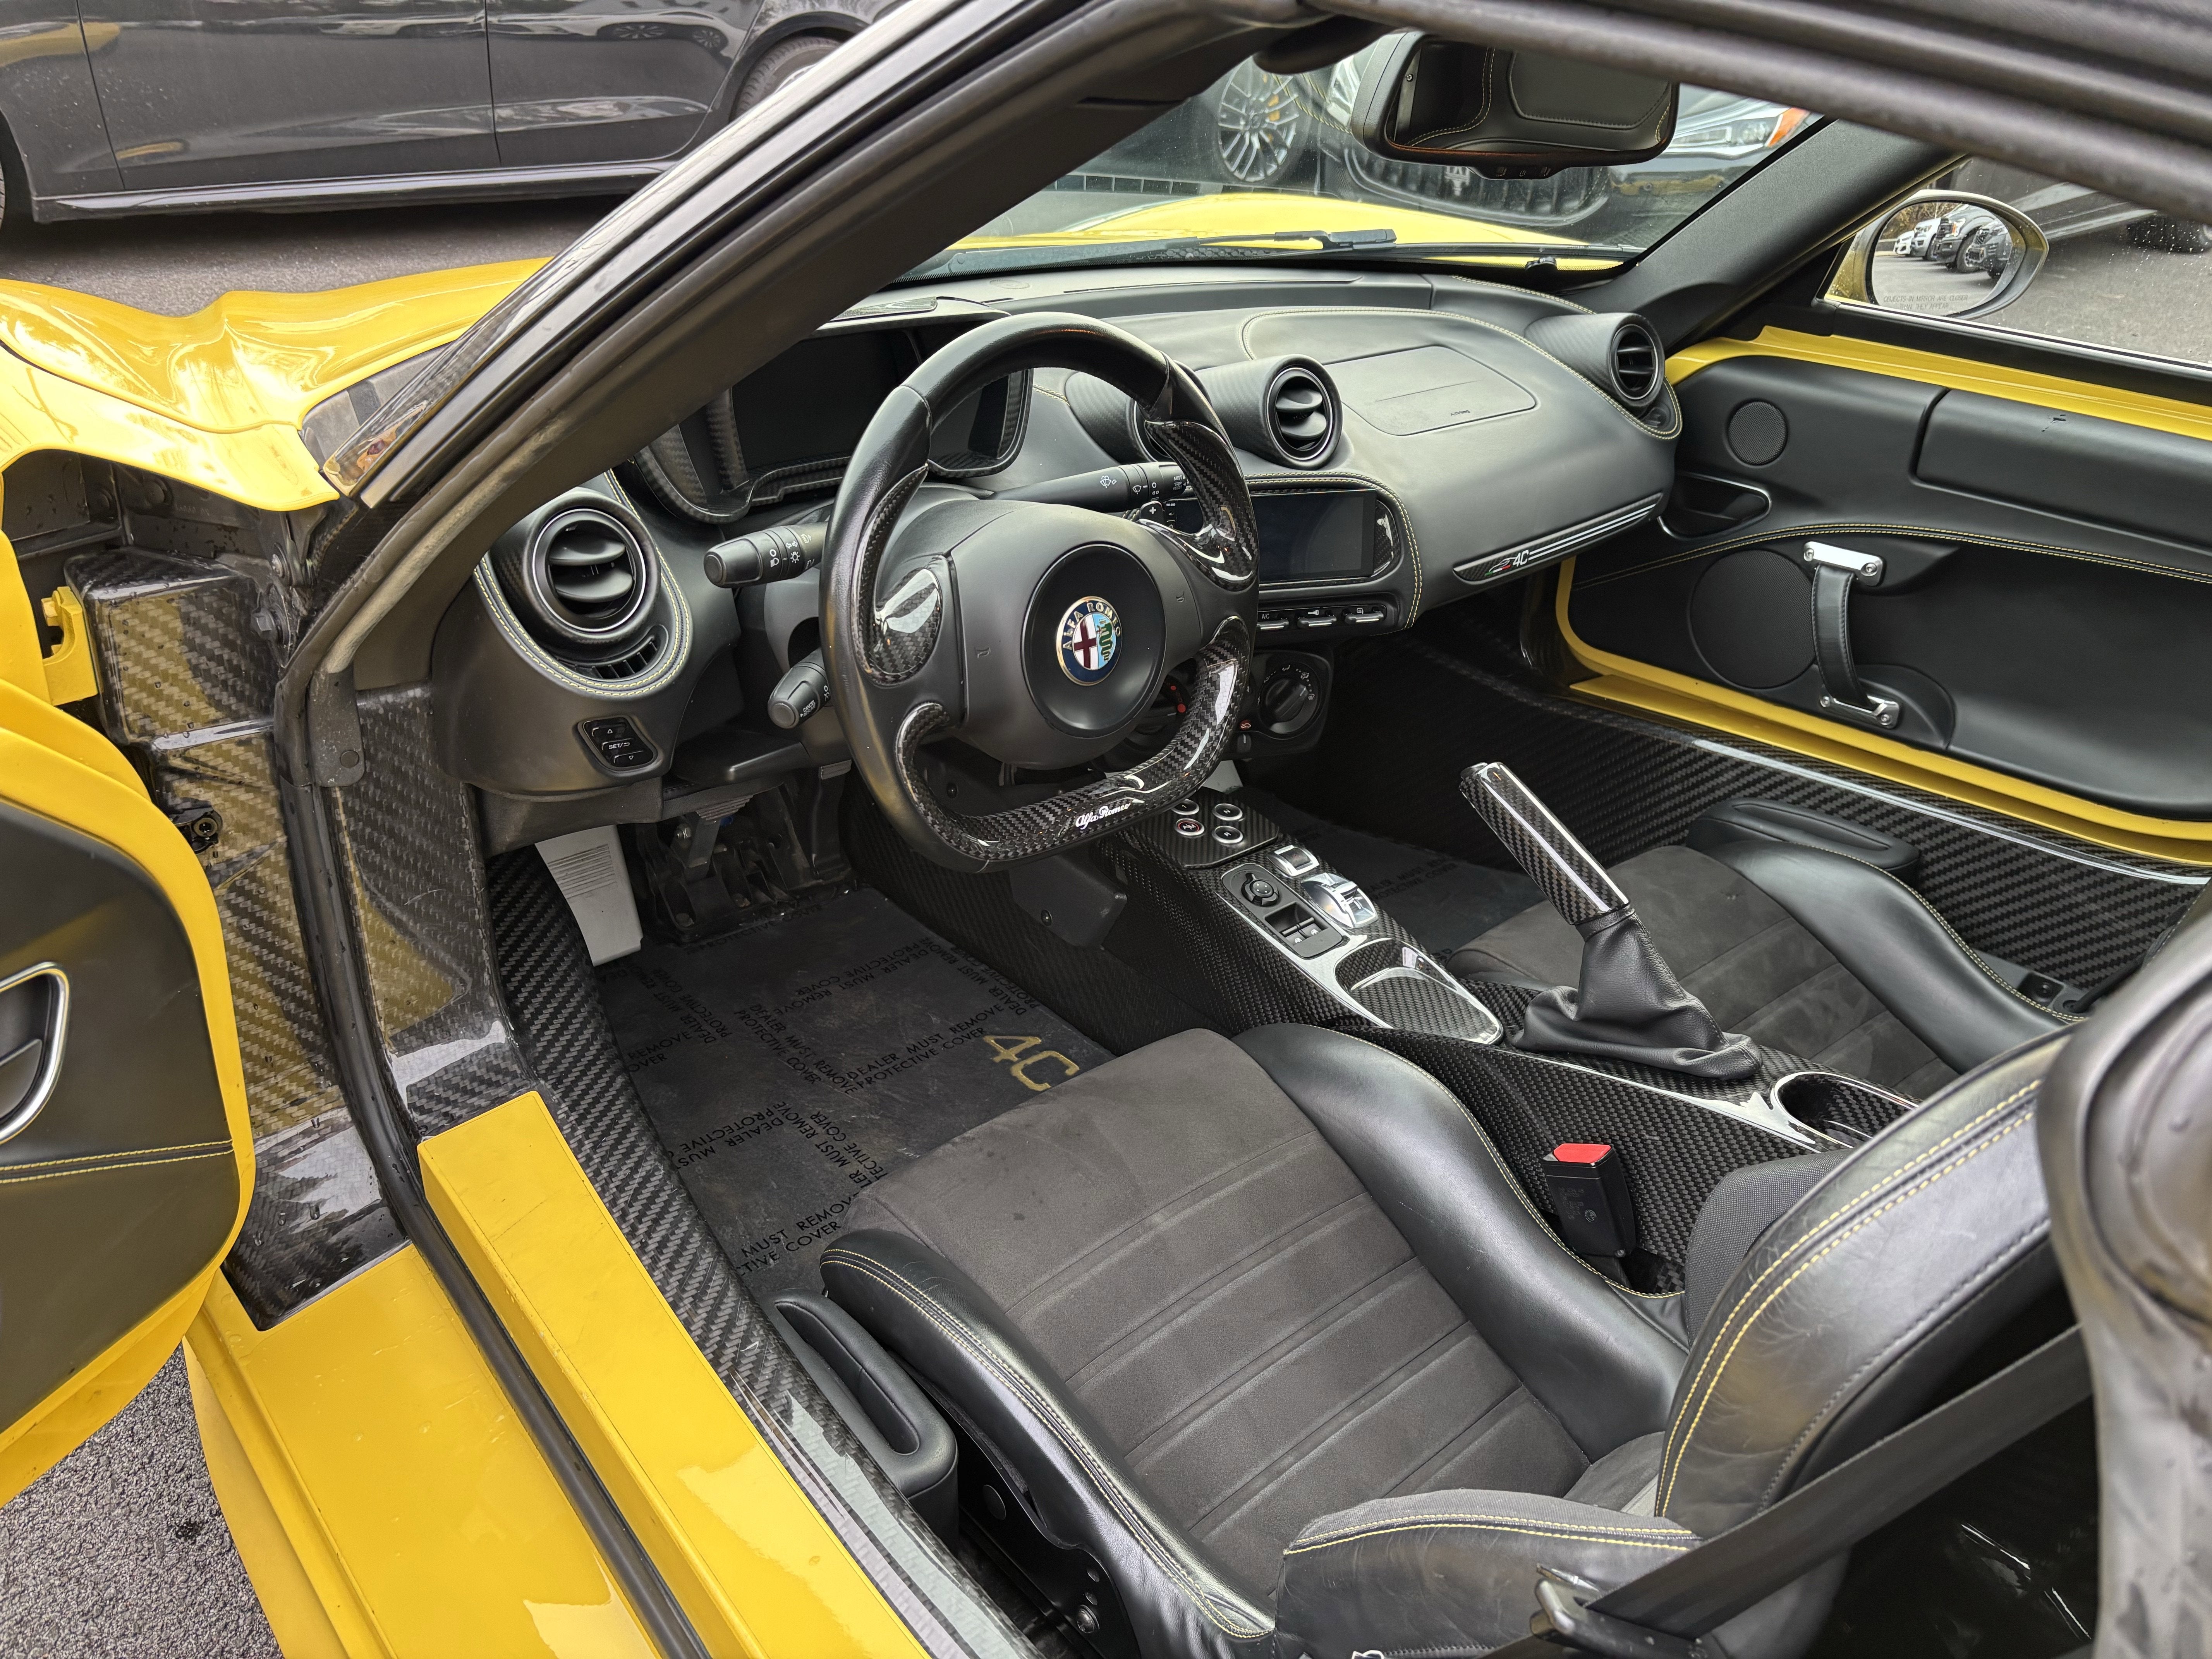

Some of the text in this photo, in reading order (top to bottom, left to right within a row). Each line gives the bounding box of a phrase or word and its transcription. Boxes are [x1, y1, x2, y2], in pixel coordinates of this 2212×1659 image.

[1512, 550, 1529, 567] 4C
[1063, 601, 1121, 651] ALFA ROMEO
[1075, 802, 1131, 830] Alfa Romeo
[773, 949, 929, 1015] DEALER MUST REMOVE
[795, 942, 920, 996] PROTECTIVE COVER
[918, 936, 1027, 1015] DEALER MUST REMOVE
[981, 968, 1041, 1009] PROTECTIVE
[679, 994, 733, 1038] PROTECTIVE
[680, 1014, 717, 1044] DEALER
[627, 1030, 693, 1060] REMOVE
[733, 1009, 822, 1085] PROTECTIVE COVER
[750, 1003, 859, 1095] DEALER MUST REMOVE
[846, 1003, 1005, 1080] DEALER MUST REMOVE
[856, 1027, 987, 1089] PROTECTIVE COVER
[982, 1035, 1080, 1092] 4C
[677, 1117, 785, 1170] DEALER MUS
[679, 1108, 775, 1153] PROTECTIVE
[773, 1101, 819, 1139] REMOVE
[810, 1111, 847, 1142] COVER
[814, 1141, 851, 1168] MUST
[741, 1192, 859, 1258] MUST REMOV
[785, 1221, 842, 1252] COVER
